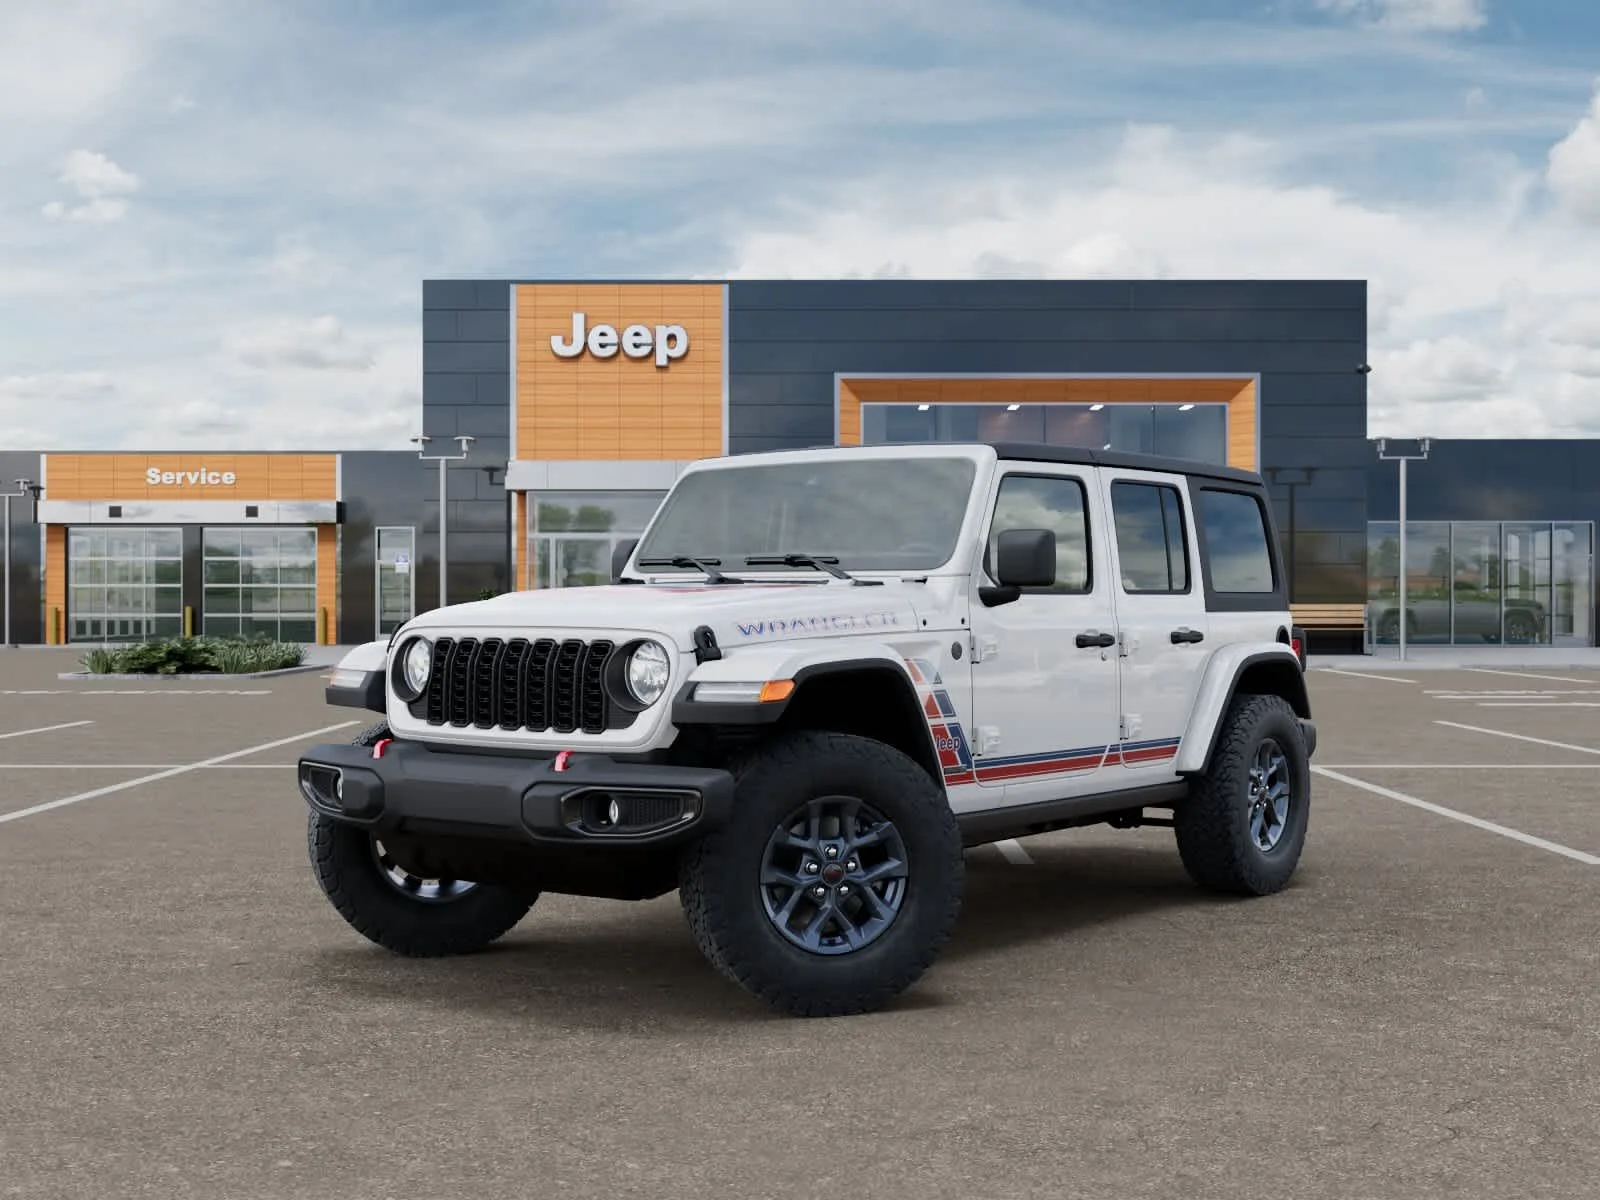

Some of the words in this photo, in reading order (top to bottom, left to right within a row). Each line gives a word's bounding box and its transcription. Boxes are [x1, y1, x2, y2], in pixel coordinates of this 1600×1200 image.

[550, 311, 689, 367] Jeep
[146, 467, 236, 485] Service
[935, 736, 961, 752] Jeep
